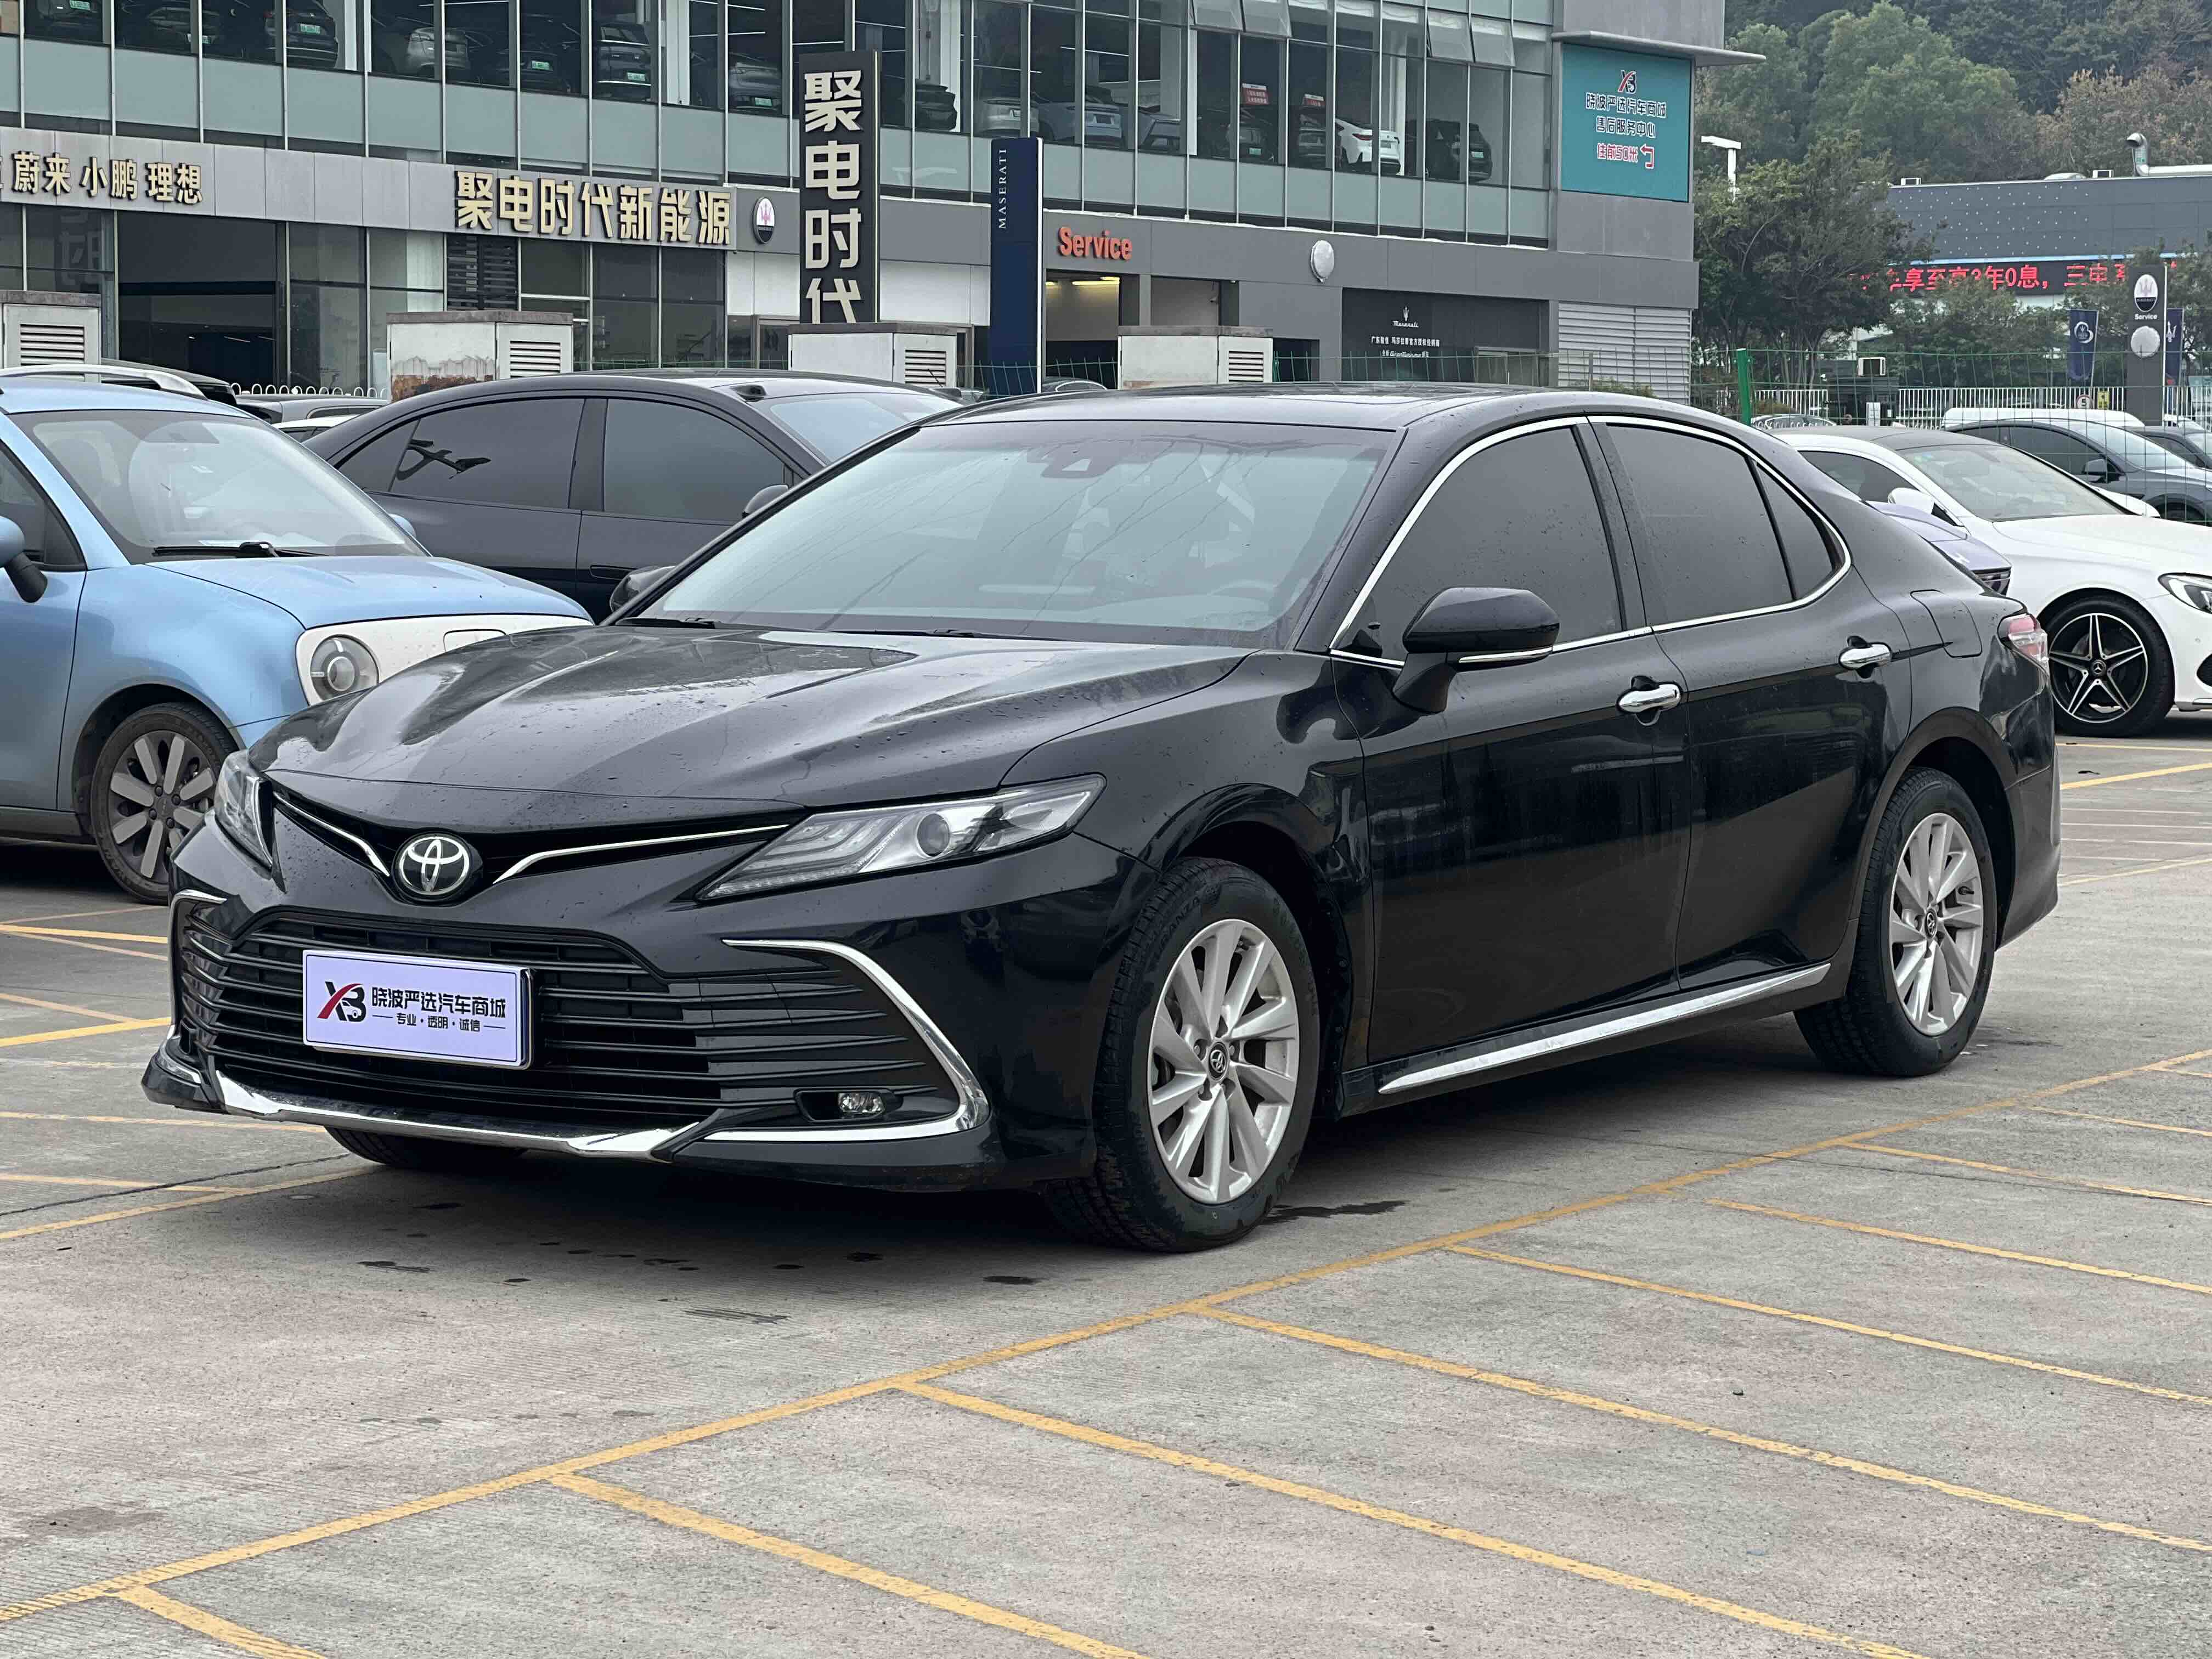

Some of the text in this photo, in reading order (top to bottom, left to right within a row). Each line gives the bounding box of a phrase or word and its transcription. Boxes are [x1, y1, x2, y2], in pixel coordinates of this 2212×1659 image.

[1585, 92, 1667, 119] 晓波严选汽车商城
[1596, 115, 1656, 138] 售后服务中心
[12, 150, 71, 196] 蔚来
[80, 156, 138, 201] 小鹏
[145, 161, 204, 205] 理想
[804, 70, 862, 324] 聚电时代
[998, 149, 1007, 229] MASERATI
[455, 171, 732, 245] 聚电时代新能源
[1058, 227, 1133, 261] Service
[371, 987, 506, 1019] 晓波严选汽车商城
